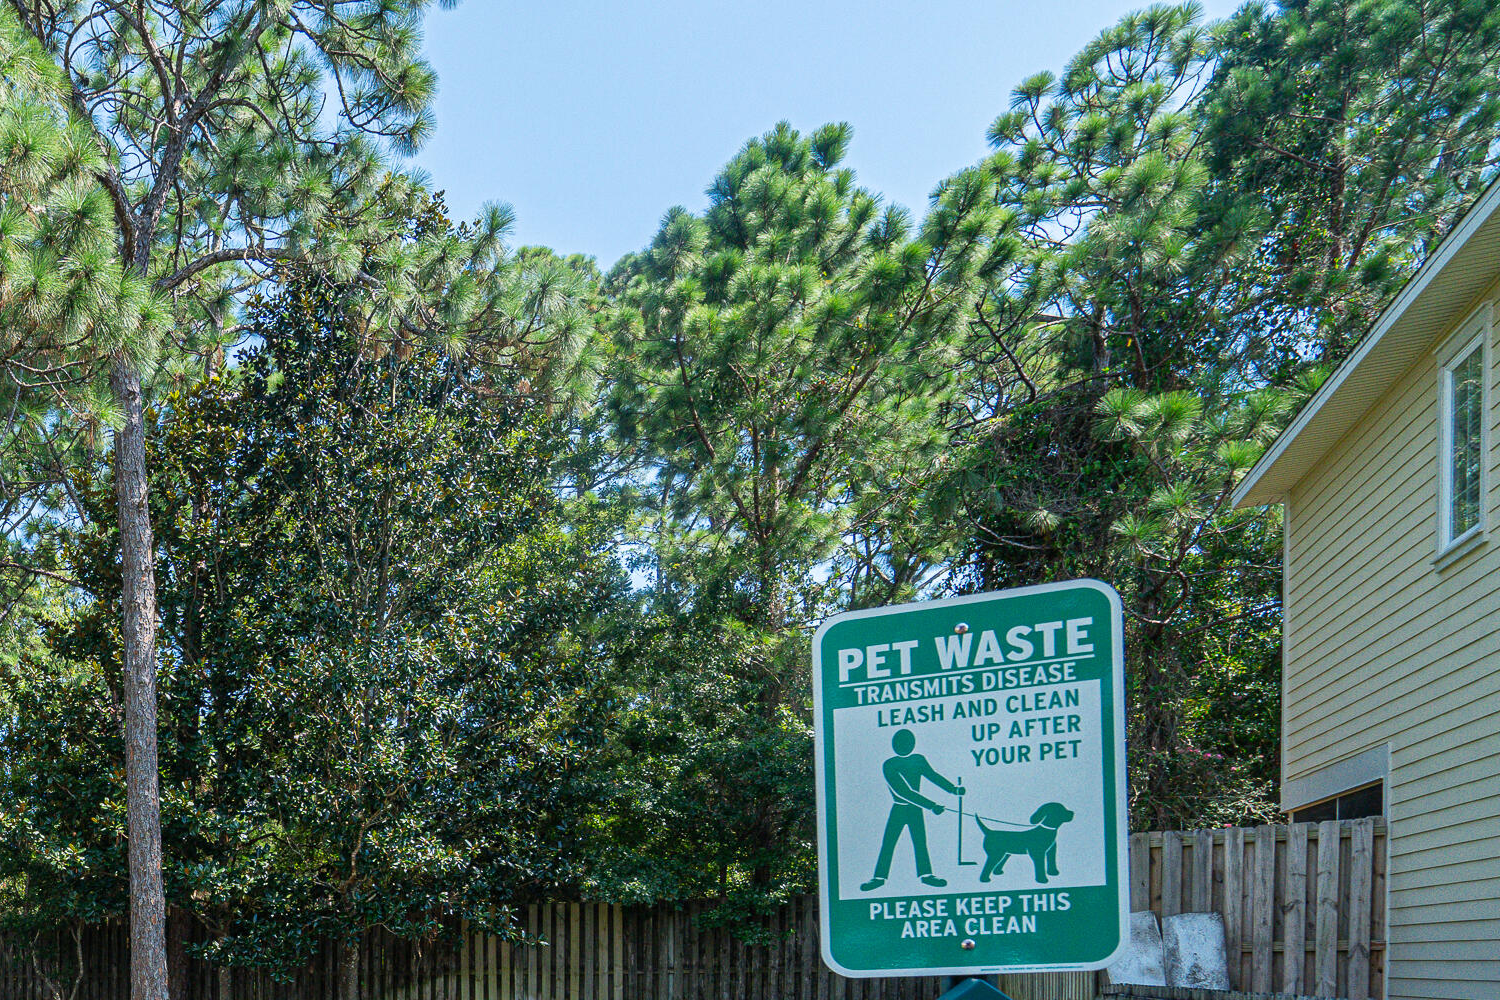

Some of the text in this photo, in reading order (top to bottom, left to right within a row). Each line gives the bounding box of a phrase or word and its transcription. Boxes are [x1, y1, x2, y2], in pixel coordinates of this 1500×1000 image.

[838, 616, 1094, 682] PET WASTE
[854, 662, 1077, 705] TRANSMITS DISEASE
[878, 688, 1080, 727] LEASH AND CLEAN
[971, 714, 1081, 742] UP AFTER
[971, 740, 1082, 767] YOUR PET
[869, 892, 1071, 920] PLEASE KEEP THIS
[901, 915, 1037, 938] AREA CLEAN
